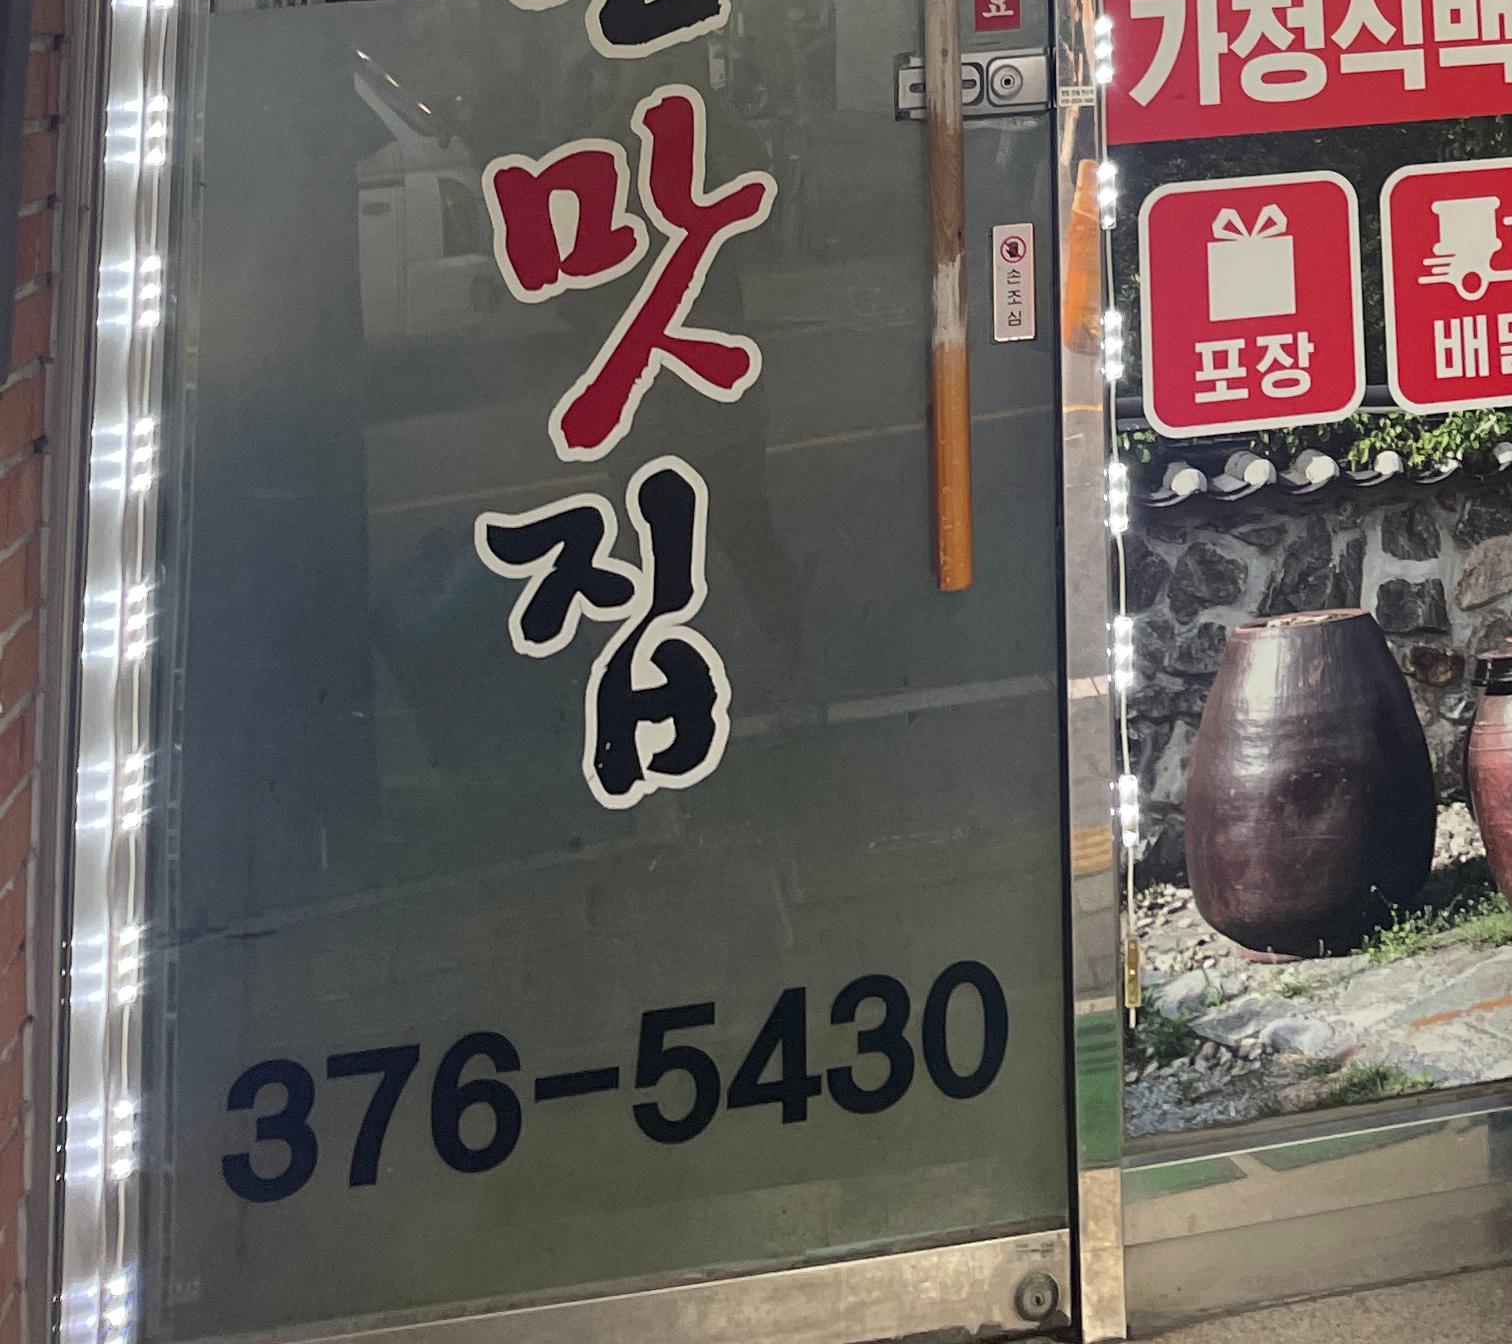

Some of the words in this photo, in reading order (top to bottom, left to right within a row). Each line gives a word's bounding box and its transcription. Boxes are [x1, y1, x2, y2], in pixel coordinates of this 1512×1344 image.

[1006, 268, 1023, 327] 손조심
[1194, 332, 1316, 405] 포장
[221, 960, 1010, 1204] 376-5430
